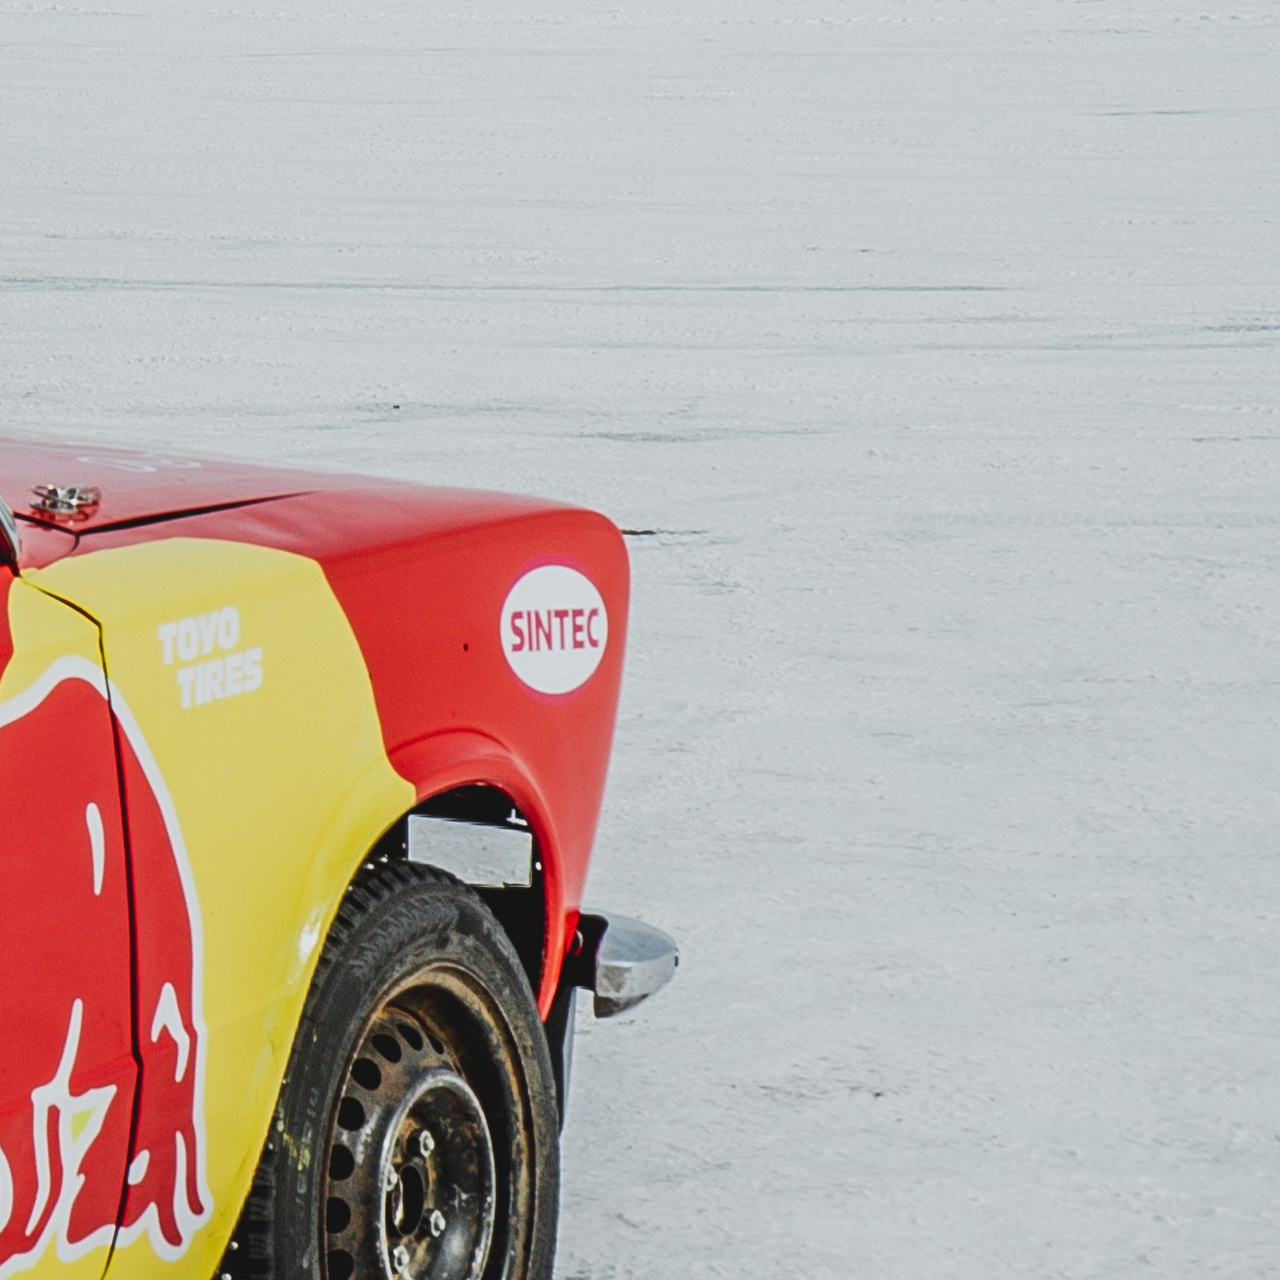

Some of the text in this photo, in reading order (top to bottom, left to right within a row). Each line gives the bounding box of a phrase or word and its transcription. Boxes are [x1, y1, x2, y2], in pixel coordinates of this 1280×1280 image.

[157, 605, 239, 666] TOYO
[510, 608, 600, 652] SINTEC
[176, 646, 263, 710] TIRES
